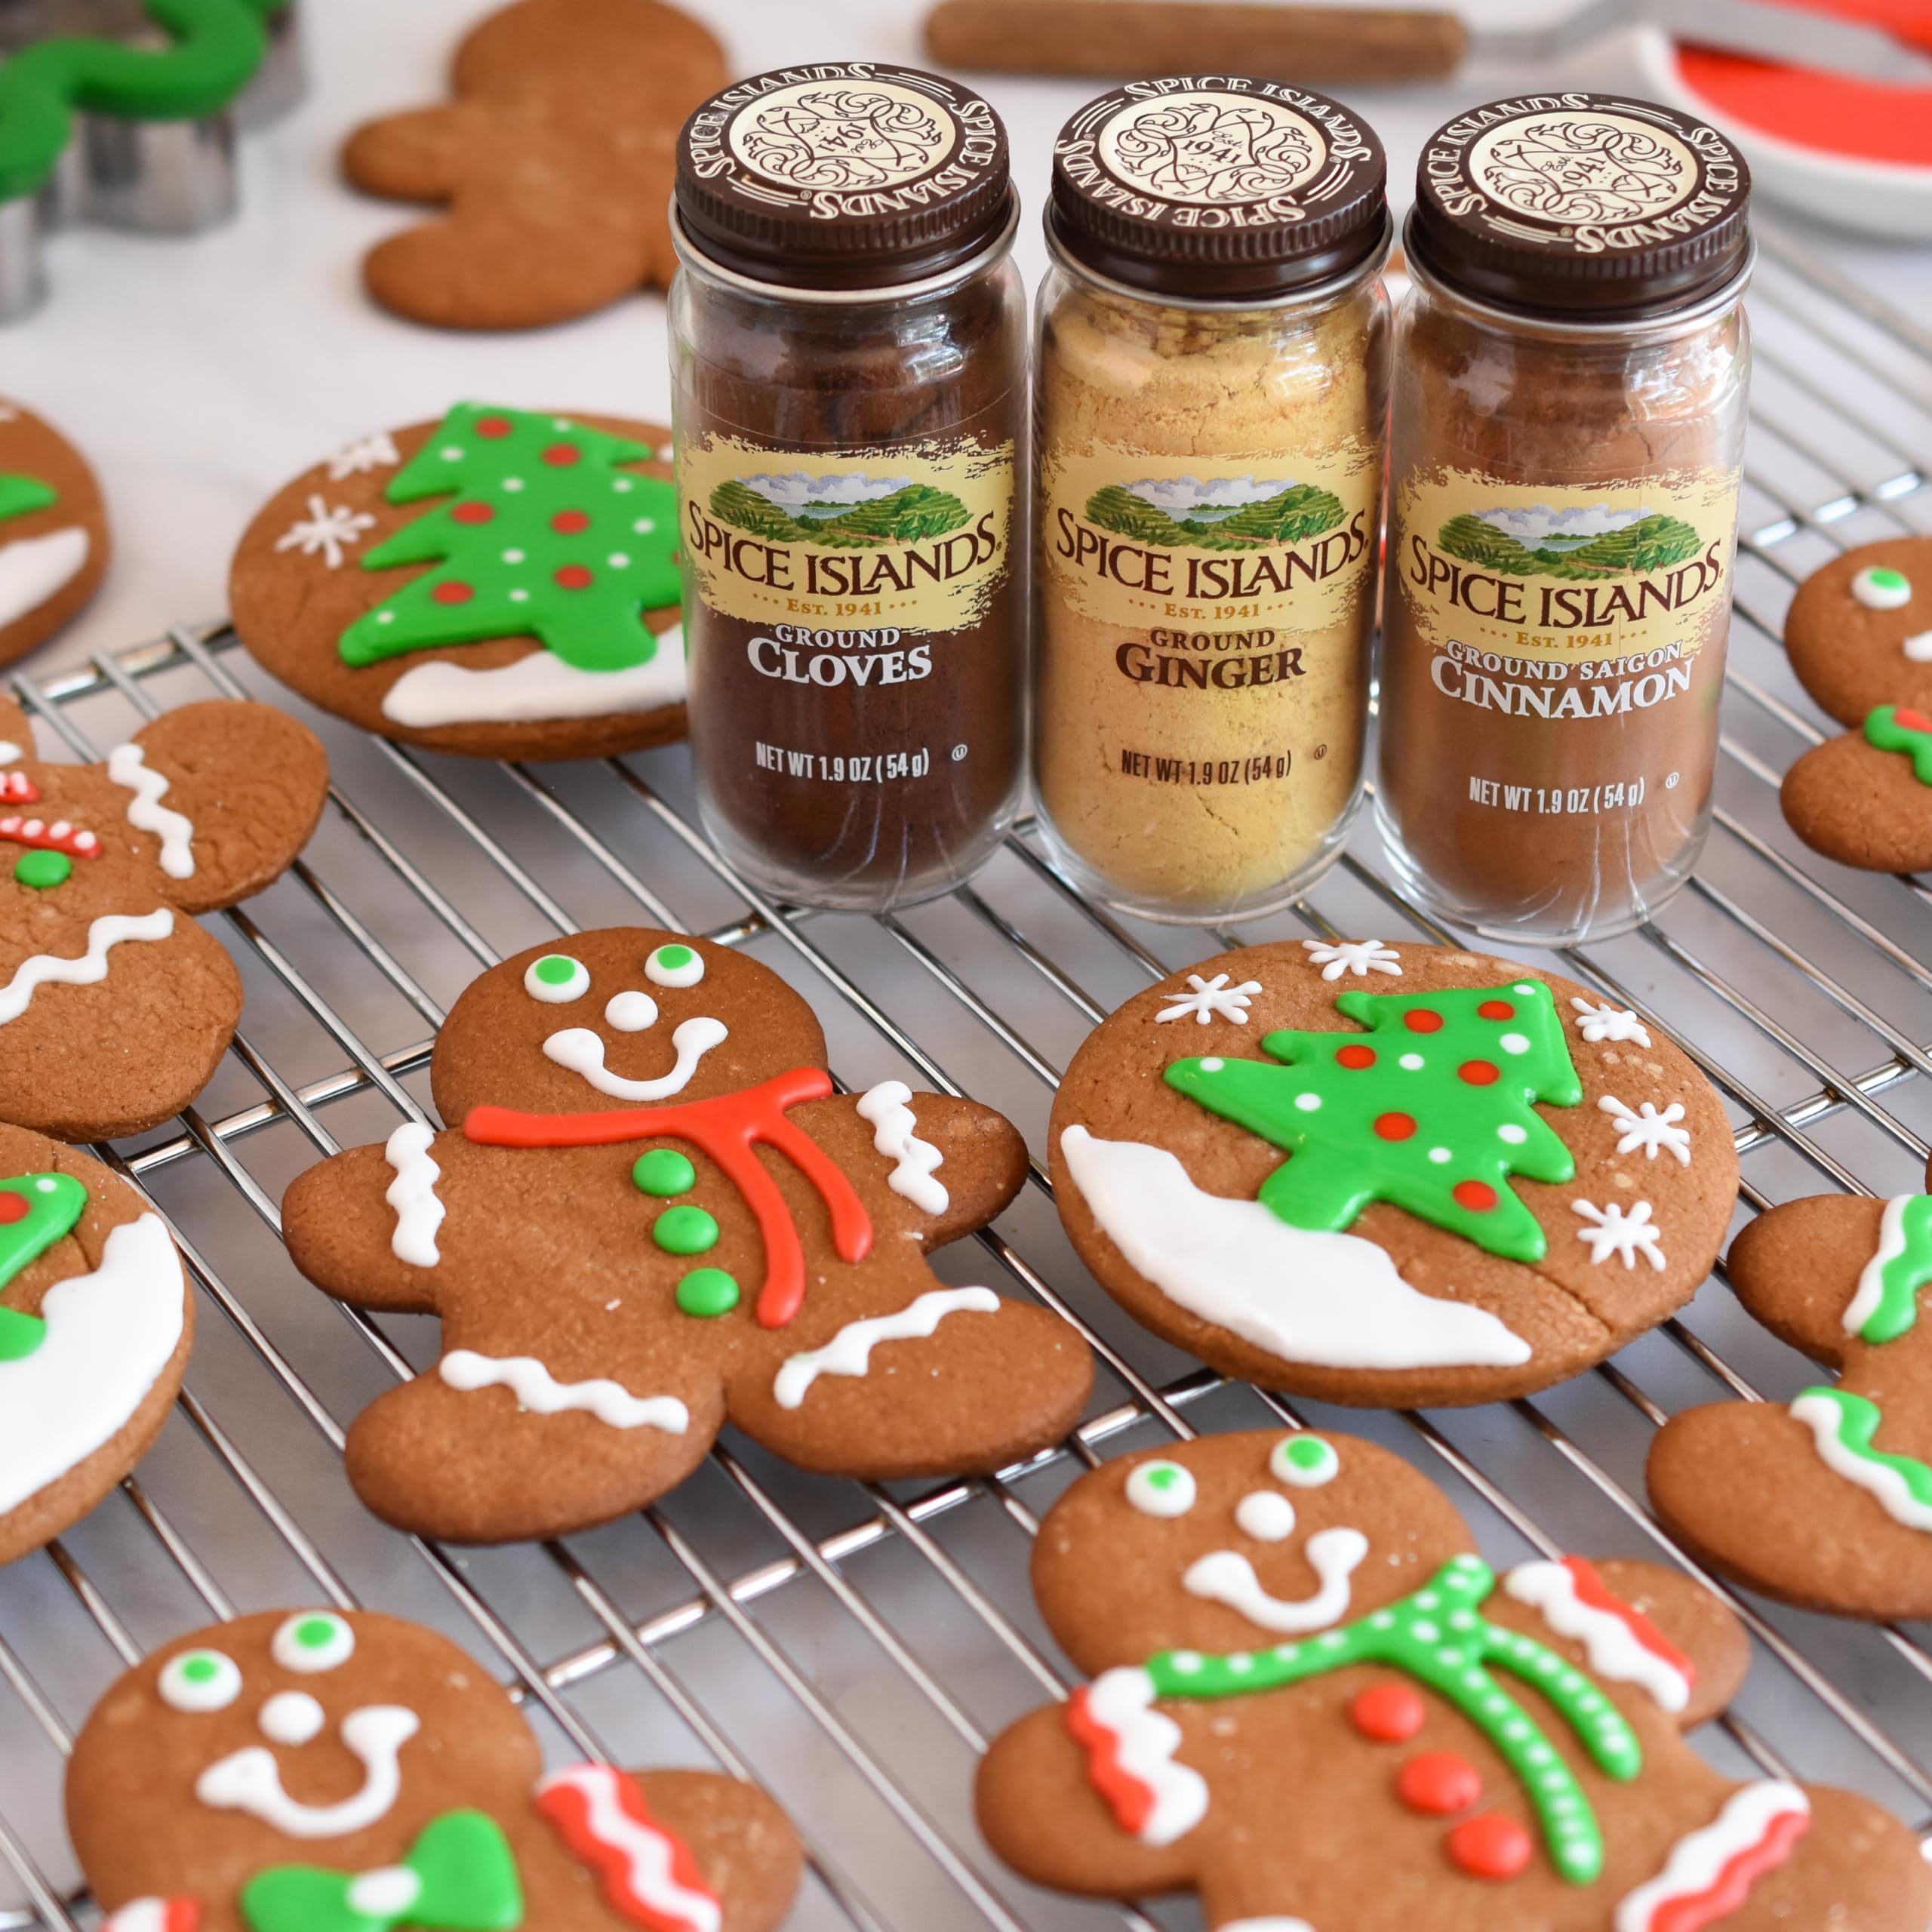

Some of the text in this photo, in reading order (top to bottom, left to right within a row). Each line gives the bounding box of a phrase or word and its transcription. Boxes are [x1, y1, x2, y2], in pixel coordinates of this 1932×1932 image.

[690, 63, 875, 178] SPICE ISLANDS
[817, 122, 869, 152] 1941
[1124, 77, 1372, 163] SPICE ISLANDS
[810, 100, 997, 219] SPICE ISLANDS
[1180, 140, 1238, 165] 1941
[1427, 94, 1589, 216] SPICE ISLANDS
[1561, 157, 1606, 187] 1941
[1056, 139, 1306, 228] SPICE ISLANDS
[1575, 128, 1739, 253] SPICE ISLANDS
[688, 500, 996, 597] SPICE ISLANDS
[1057, 507, 1365, 599] SPICE ISLANDS
[1410, 534, 1721, 629] SPICE ISLANDS
[786, 598, 882, 617] EST. 1941
[1164, 602, 1260, 620] EST. 1941
[775, 623, 900, 649] GROUND
[1149, 629, 1275, 651] GROUND
[1515, 631, 1613, 648] EST. 1941
[747, 637, 932, 688] CLOVES
[1115, 641, 1306, 691] GINGER
[1447, 639, 1683, 681] GROUND SAIGON
[1430, 655, 1695, 719] CINNAMON
[755, 741, 784, 773] NET
[787, 750, 814, 780] WT
[819, 755, 844, 782] 1.9
[848, 757, 872, 782] OZ
[1121, 749, 1152, 778] NET
[1155, 758, 1183, 783] WT
[1189, 761, 1213, 786] 1.9
[1218, 760, 1240, 784] OZ
[1469, 776, 1500, 807] NET
[1503, 785, 1532, 812] WT
[1537, 789, 1562, 814] 1.9
[1567, 788, 1589, 814] OZ
